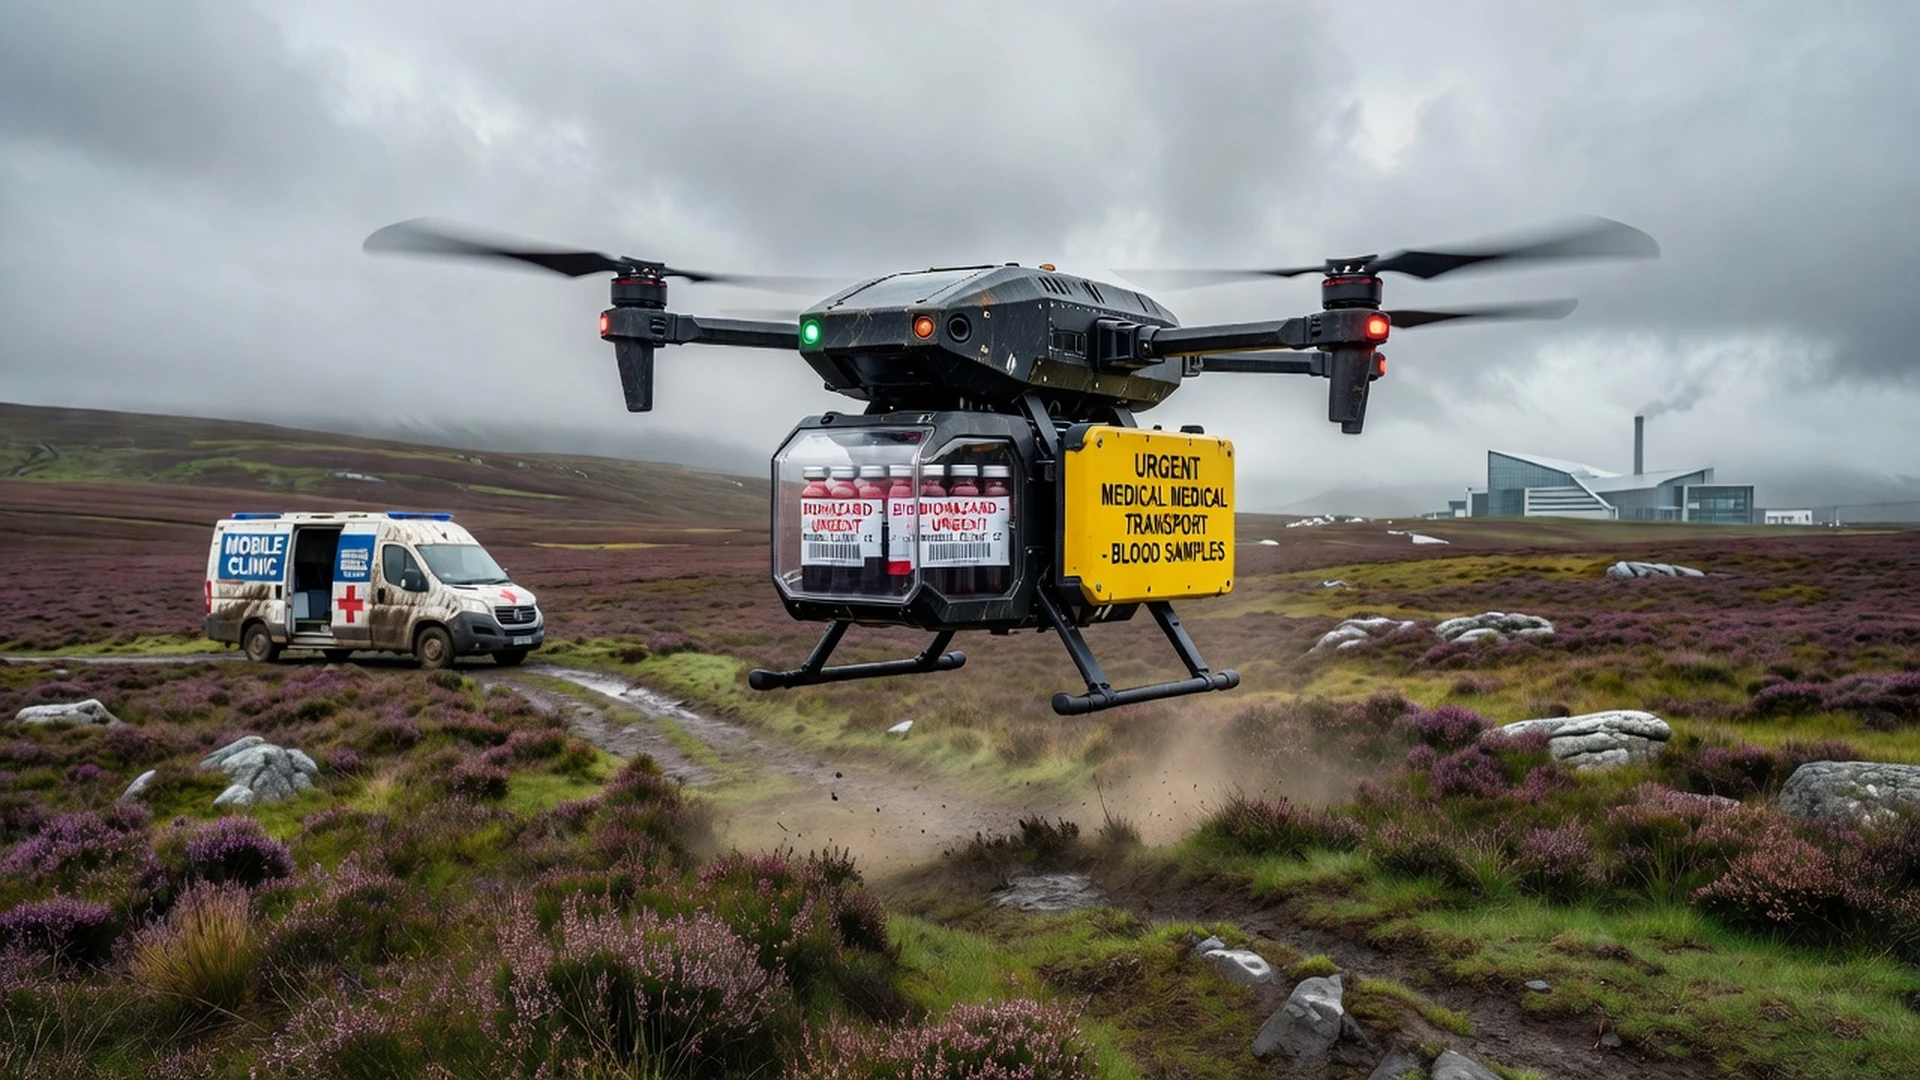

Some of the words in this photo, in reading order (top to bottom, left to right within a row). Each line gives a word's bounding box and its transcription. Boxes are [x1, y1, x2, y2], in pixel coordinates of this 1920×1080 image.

[1135, 453, 1200, 480] URGENT
[1101, 483, 1167, 507] MEDICAL
[1171, 486, 1228, 508] MEDICAL
[1125, 513, 1208, 535] TRANSPORT
[225, 535, 284, 555] MOBILE
[1111, 542, 1160, 564] BLOOD
[1164, 541, 1225, 563] SAMPLES
[227, 556, 277, 576] CLINIC
